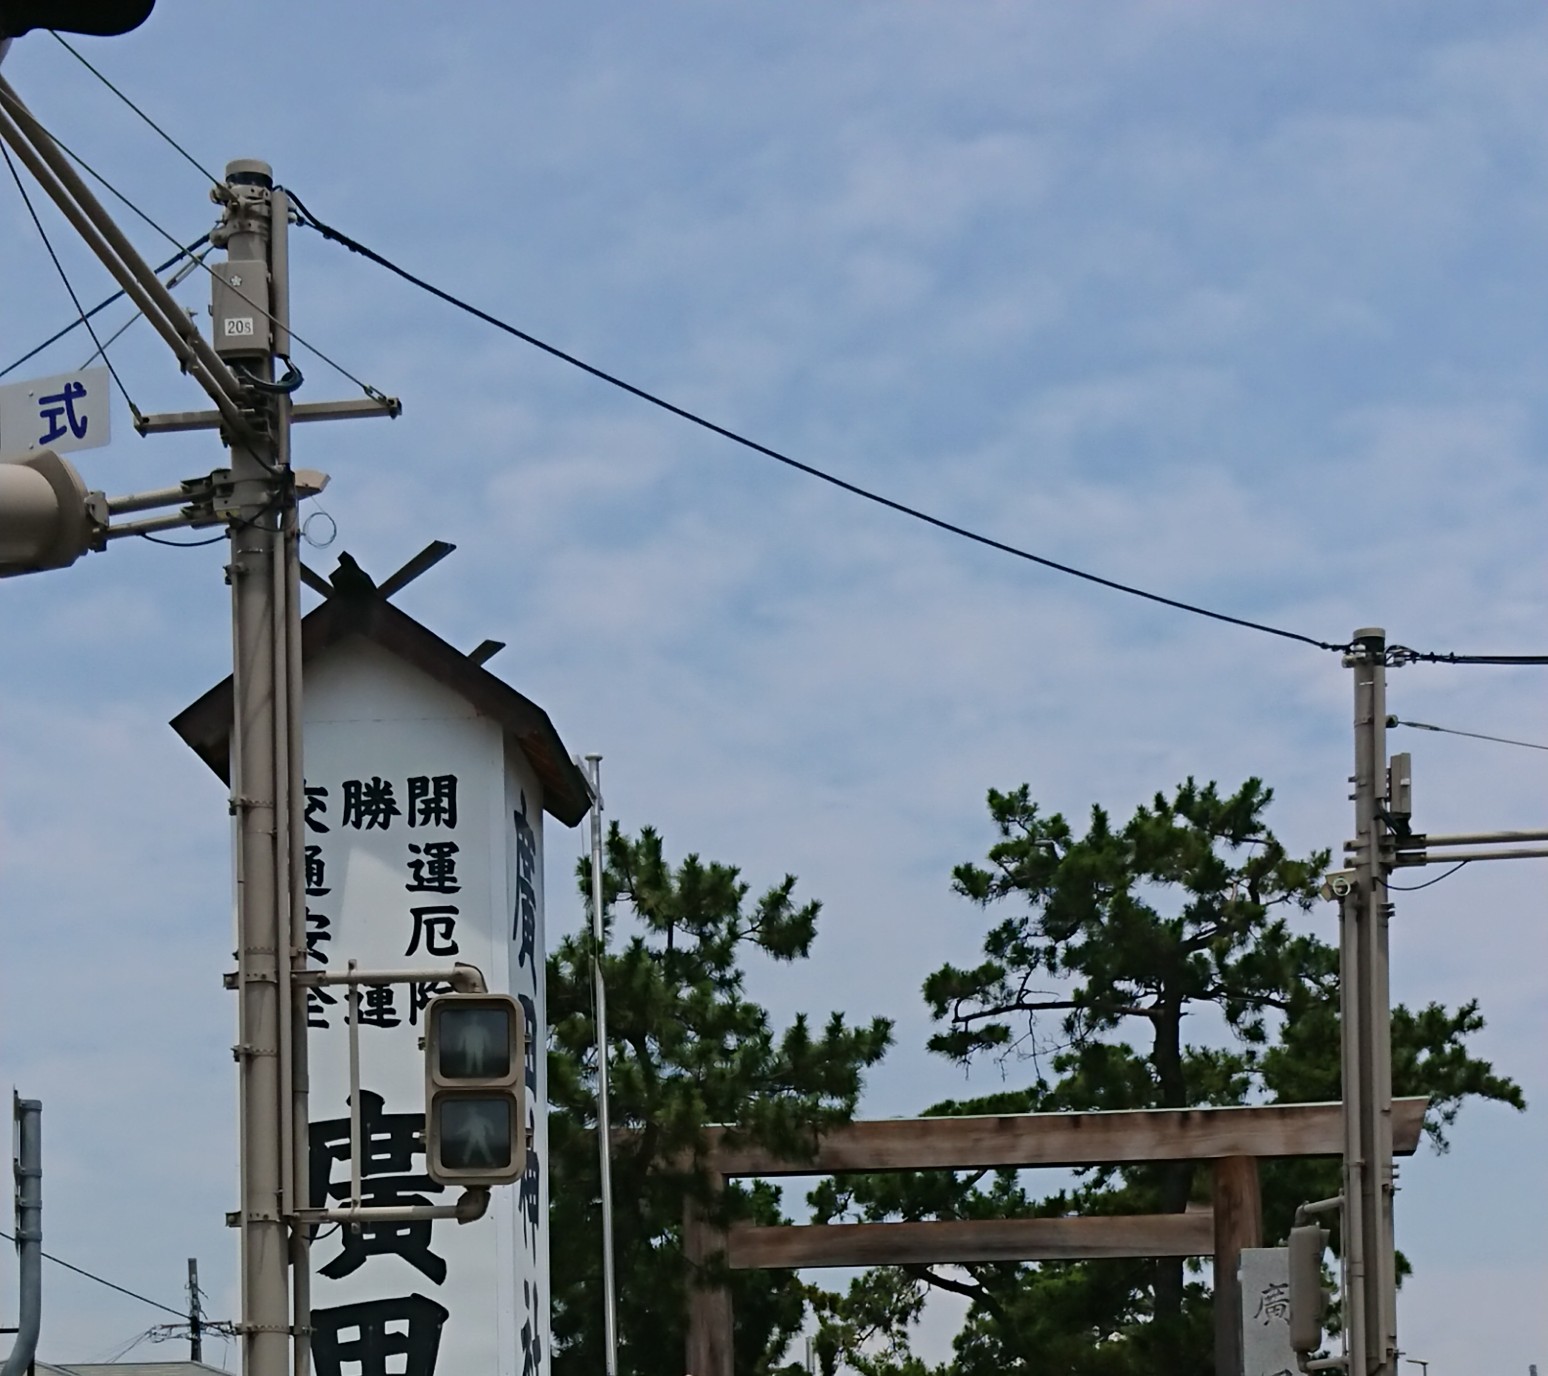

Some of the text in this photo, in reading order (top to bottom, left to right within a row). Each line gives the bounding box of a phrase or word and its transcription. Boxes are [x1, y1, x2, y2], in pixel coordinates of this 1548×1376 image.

[38, 381, 88, 446] 式
[405, 773, 462, 1026] 開運厄
